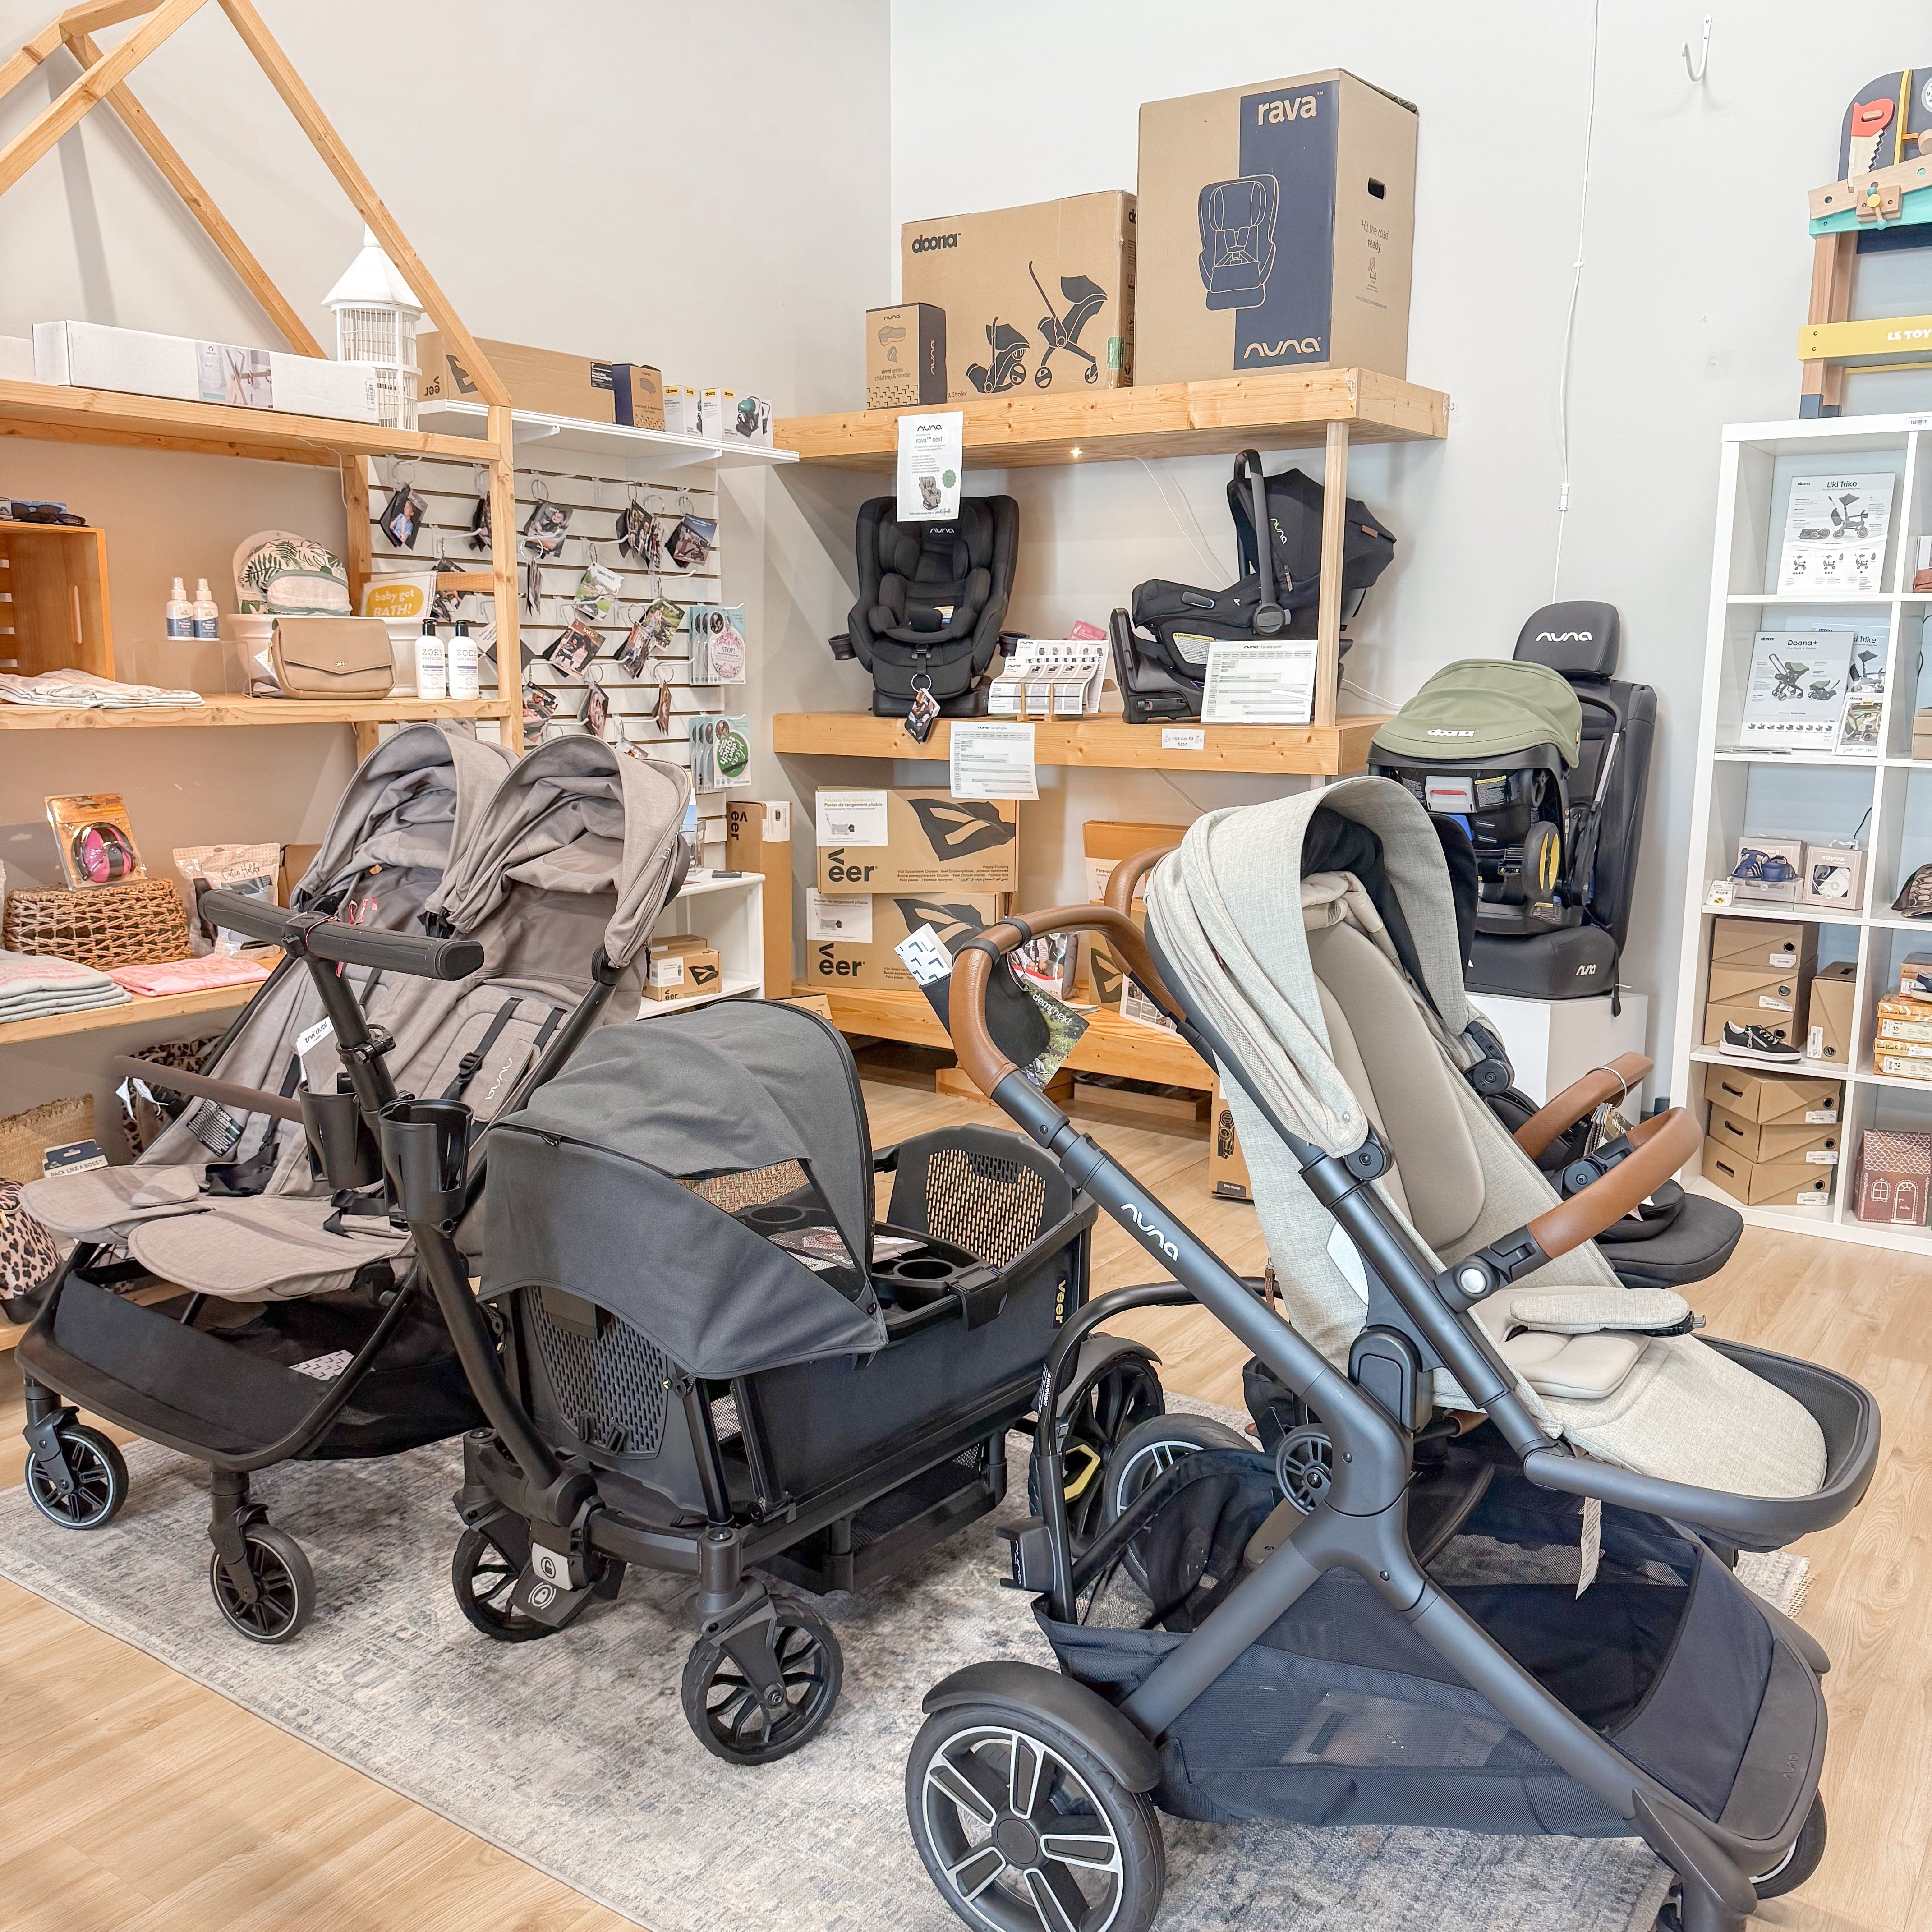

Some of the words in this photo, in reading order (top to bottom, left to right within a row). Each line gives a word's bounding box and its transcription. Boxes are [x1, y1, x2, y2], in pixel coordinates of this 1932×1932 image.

[1378, 230, 1389, 240] road
[1368, 239, 1381, 253] ready
[1887, 331, 1902, 341] LE
[1904, 329, 1932, 339] TOY
[1244, 336, 1321, 359] nuna
[1270, 518, 1288, 545] nuna
[375, 591, 397, 603] baby
[399, 589, 414, 602] got
[373, 603, 413, 617] BATH!
[1535, 631, 1593, 643] nuna
[1427, 728, 1474, 738] doona
[1576, 964, 1596, 976] nuna
[1032, 993, 1054, 1015] demi
[1053, 1008, 1072, 1026] next
[316, 1021, 327, 1035] dubl
[486, 1058, 513, 1100] nuna
[67, 1165, 79, 1173] LIKE
[1120, 1203, 1179, 1262] nuna
